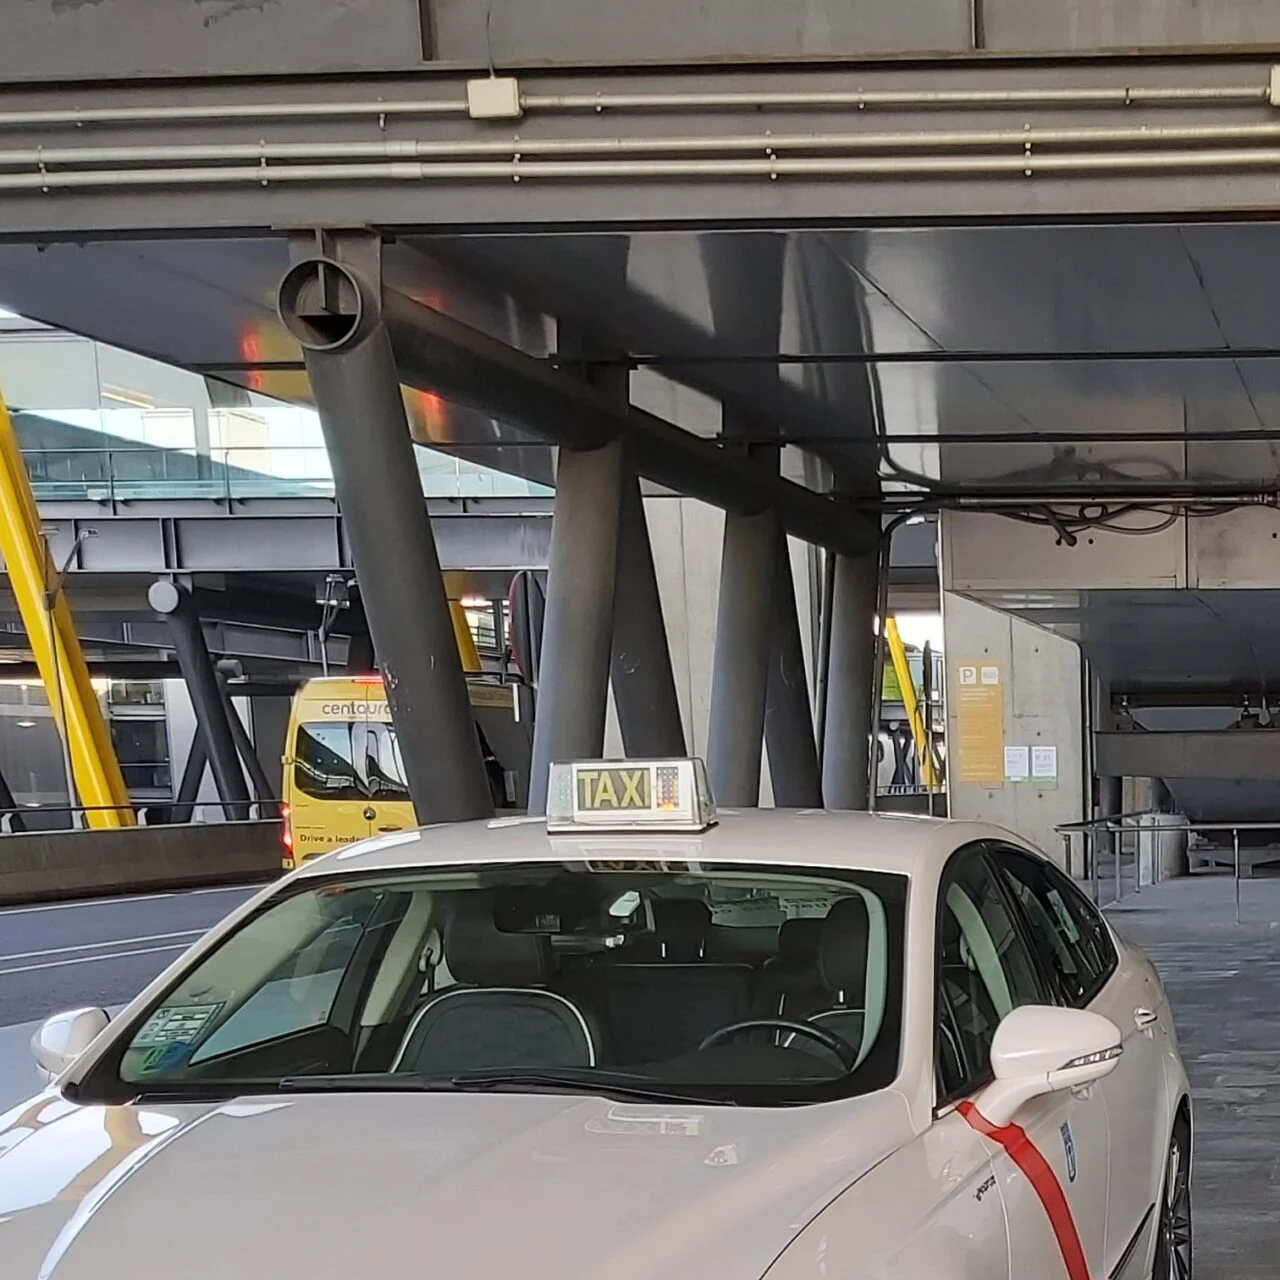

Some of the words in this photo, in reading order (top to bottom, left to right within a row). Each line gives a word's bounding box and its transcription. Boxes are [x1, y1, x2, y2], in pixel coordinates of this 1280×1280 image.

[963, 669, 974, 683] P
[577, 769, 649, 809] TAXI
[300, 834, 325, 842] Drive
